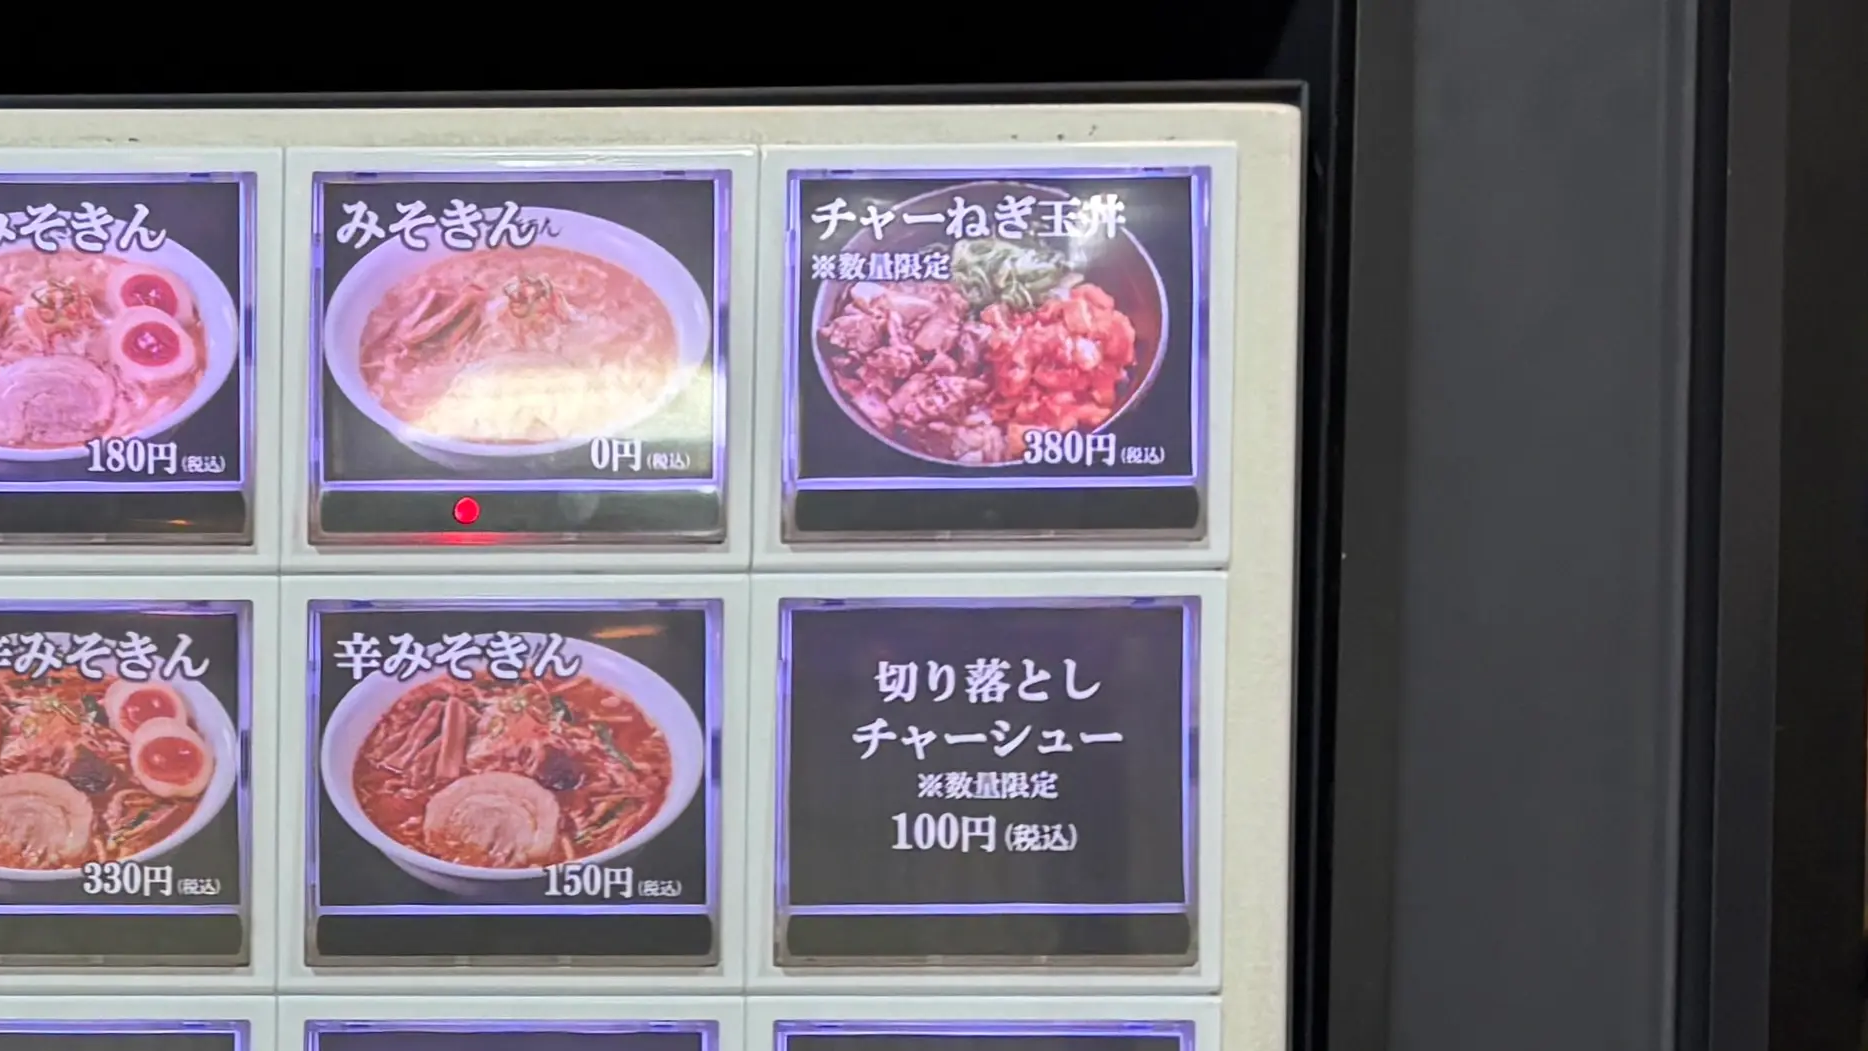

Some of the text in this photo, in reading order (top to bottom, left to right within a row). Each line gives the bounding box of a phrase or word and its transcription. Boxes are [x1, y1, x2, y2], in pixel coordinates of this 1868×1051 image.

[337, 199, 534, 248] みそきん
[811, 194, 1126, 240] チャーねぎ玉丼
[334, 633, 581, 680] 辛みそきん
[874, 658, 1101, 703] 切り落とし
[852, 718, 1124, 760] チャーシュー
